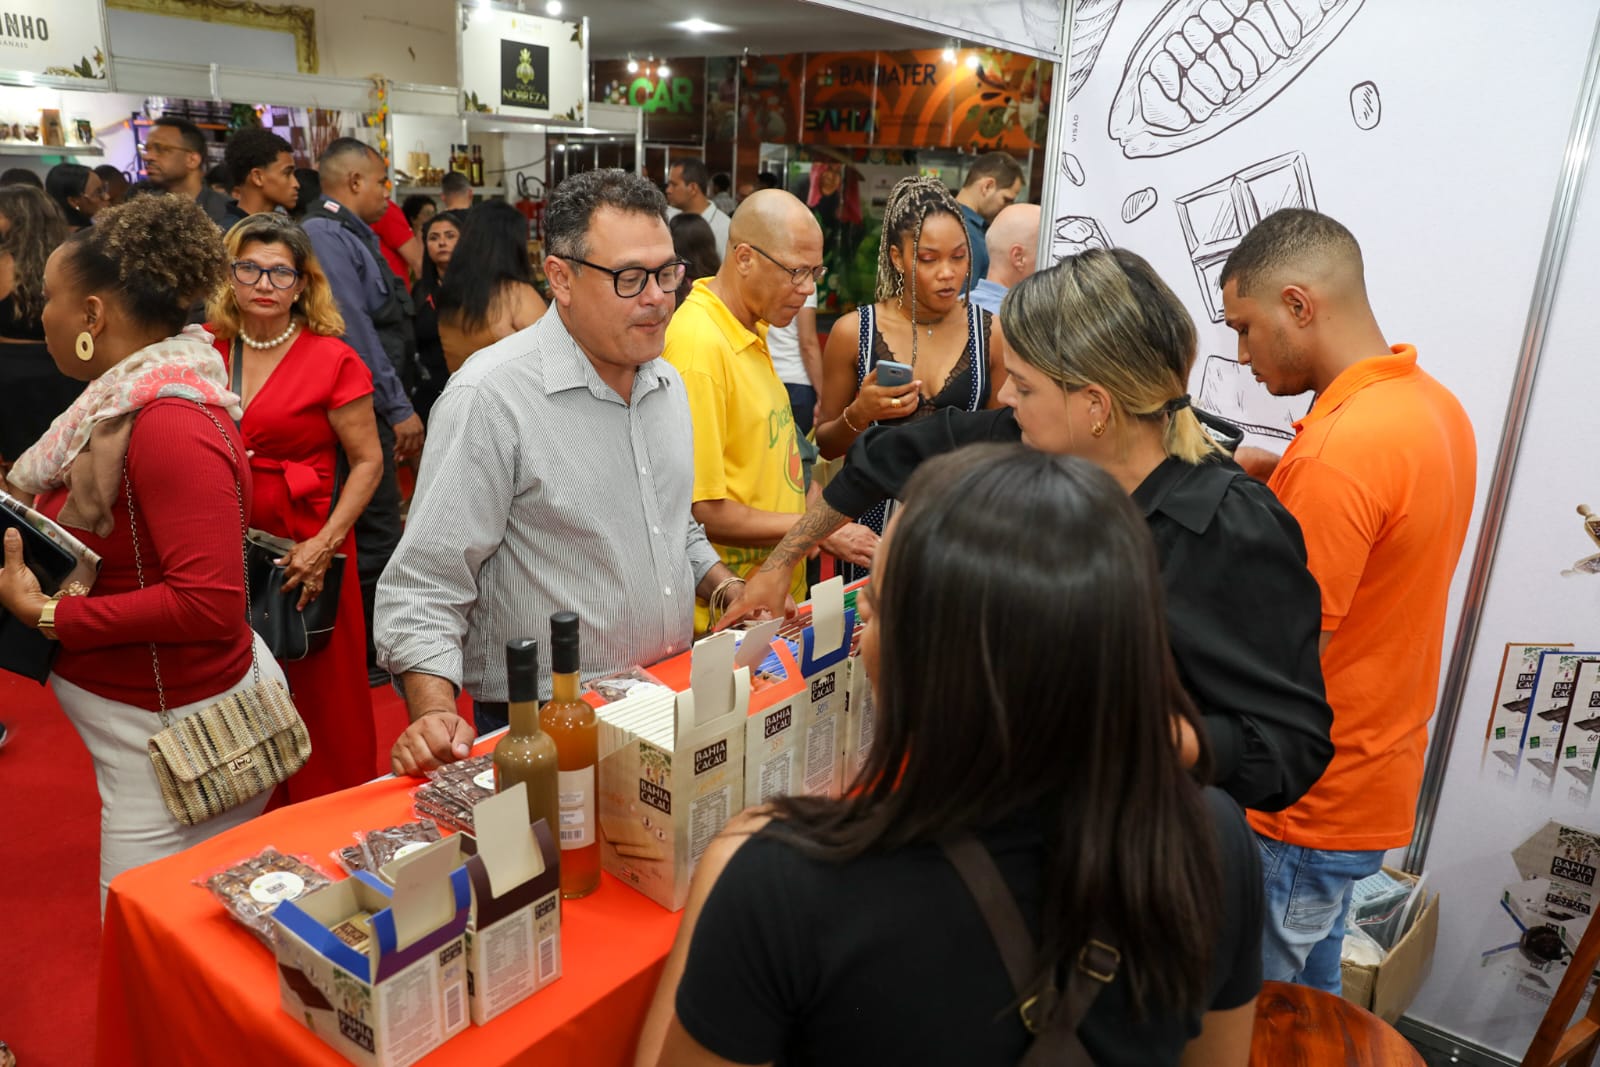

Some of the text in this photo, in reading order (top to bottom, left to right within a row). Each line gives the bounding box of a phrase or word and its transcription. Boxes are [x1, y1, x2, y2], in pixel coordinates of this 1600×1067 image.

[839, 64, 937, 86] BAHIATER
[628, 77, 694, 113] CAR
[812, 682, 834, 700] CACAU
[766, 707, 792, 727] BAHIA
[766, 716, 791, 737] CACAU
[695, 741, 726, 762] BAHIA
[695, 752, 726, 774] CACAU
[641, 781, 669, 801] BAHIA
[641, 791, 670, 812] CACAU
[1553, 866, 1593, 884] CACAU
[1554, 858, 1594, 877] BAHIA
